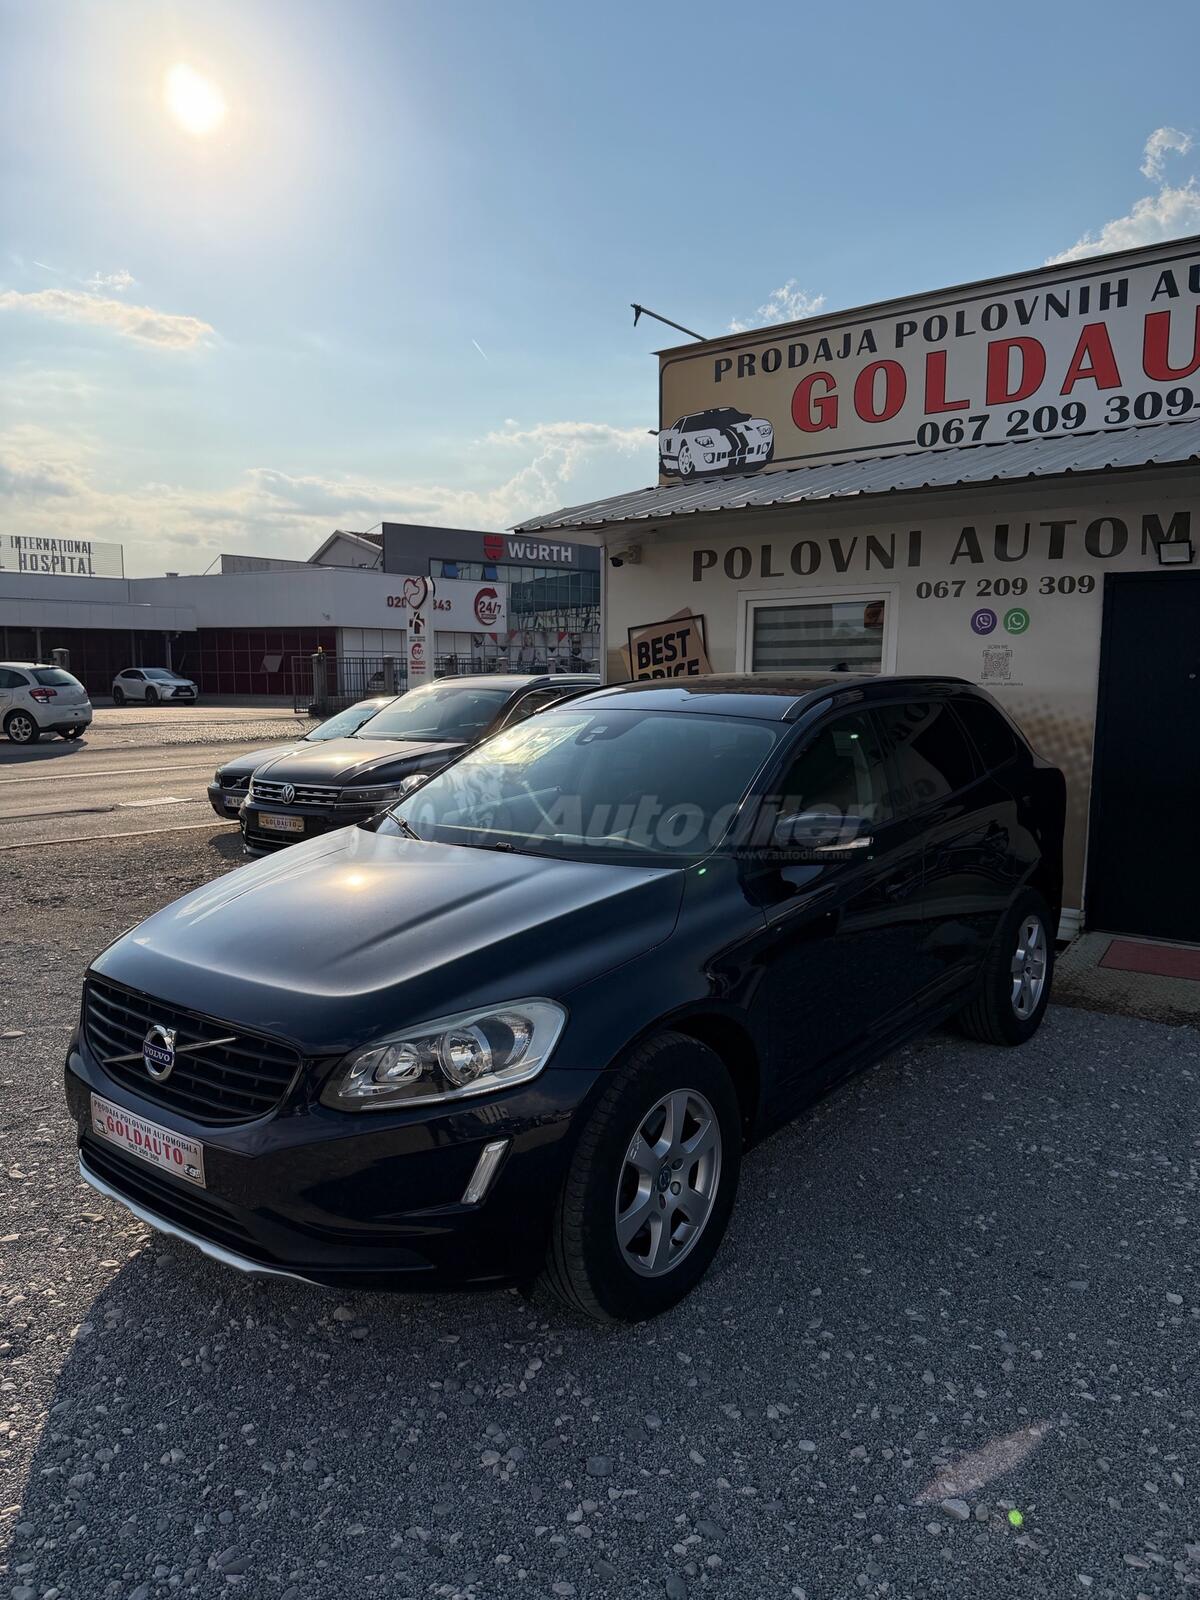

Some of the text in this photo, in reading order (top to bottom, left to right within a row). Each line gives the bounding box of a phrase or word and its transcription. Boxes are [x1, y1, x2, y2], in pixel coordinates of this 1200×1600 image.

[714, 328, 878, 383] PRODAJA
[895, 278, 1129, 348] POLOVNIH
[791, 305, 1200, 433] GOLDAU
[916, 414, 990, 448] 067
[1006, 400, 1087, 438] 209
[10, 536, 93, 554] INTERNATIONAL
[508, 541, 572, 563] WÜRTH
[692, 512, 1192, 582] POLOVNI AUTOM
[19, 553, 95, 574] HOSPITAL
[916, 574, 1096, 599] 067 209 309
[480, 601, 502, 614] 24/7
[637, 628, 690, 670] BEST
[144, 1044, 170, 1062] VOLVO
[106, 1115, 184, 1166] GOLDAUTO
[152, 1130, 199, 1156] AUTOMOBILA
